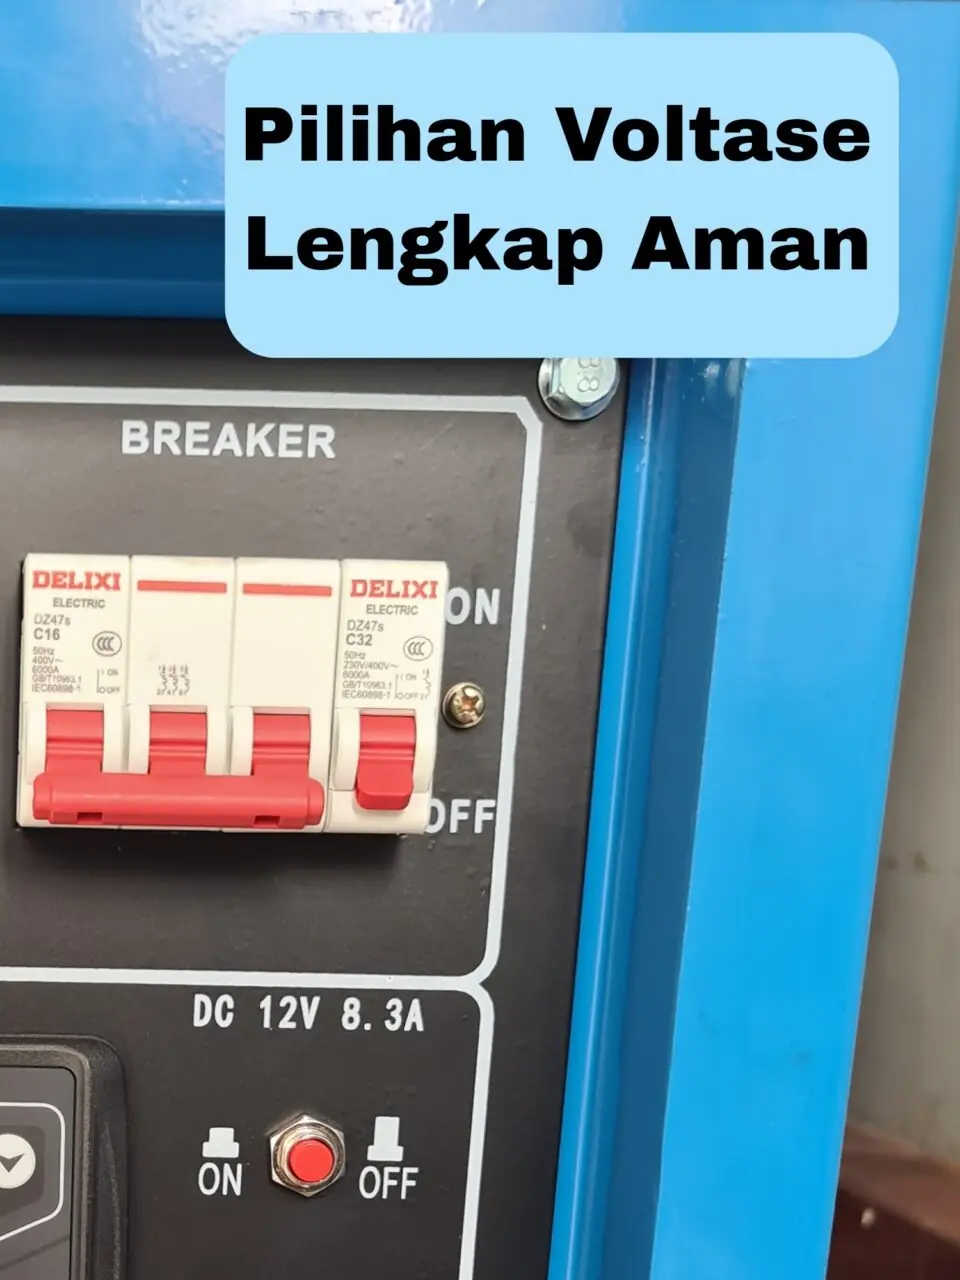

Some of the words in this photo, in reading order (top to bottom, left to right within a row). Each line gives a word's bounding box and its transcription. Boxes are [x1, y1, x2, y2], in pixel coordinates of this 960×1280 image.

[121, 420, 336, 459] BREAKER
[32, 570, 121, 591] DELIXI
[350, 579, 438, 599] DELIXI
[53, 597, 106, 609] ELECTRIC
[366, 604, 419, 616] ELECTRIC
[445, 587, 500, 625] ON
[33, 613, 71, 626] DZ47s
[347, 620, 384, 632] DZ47s
[33, 628, 61, 641] C16
[345, 633, 373, 646] C32
[425, 798, 497, 833] OFF
[193, 994, 235, 1028] DC
[260, 995, 320, 1030] 12V
[198, 1163, 242, 1196] ON
[359, 1166, 419, 1200] OFF
